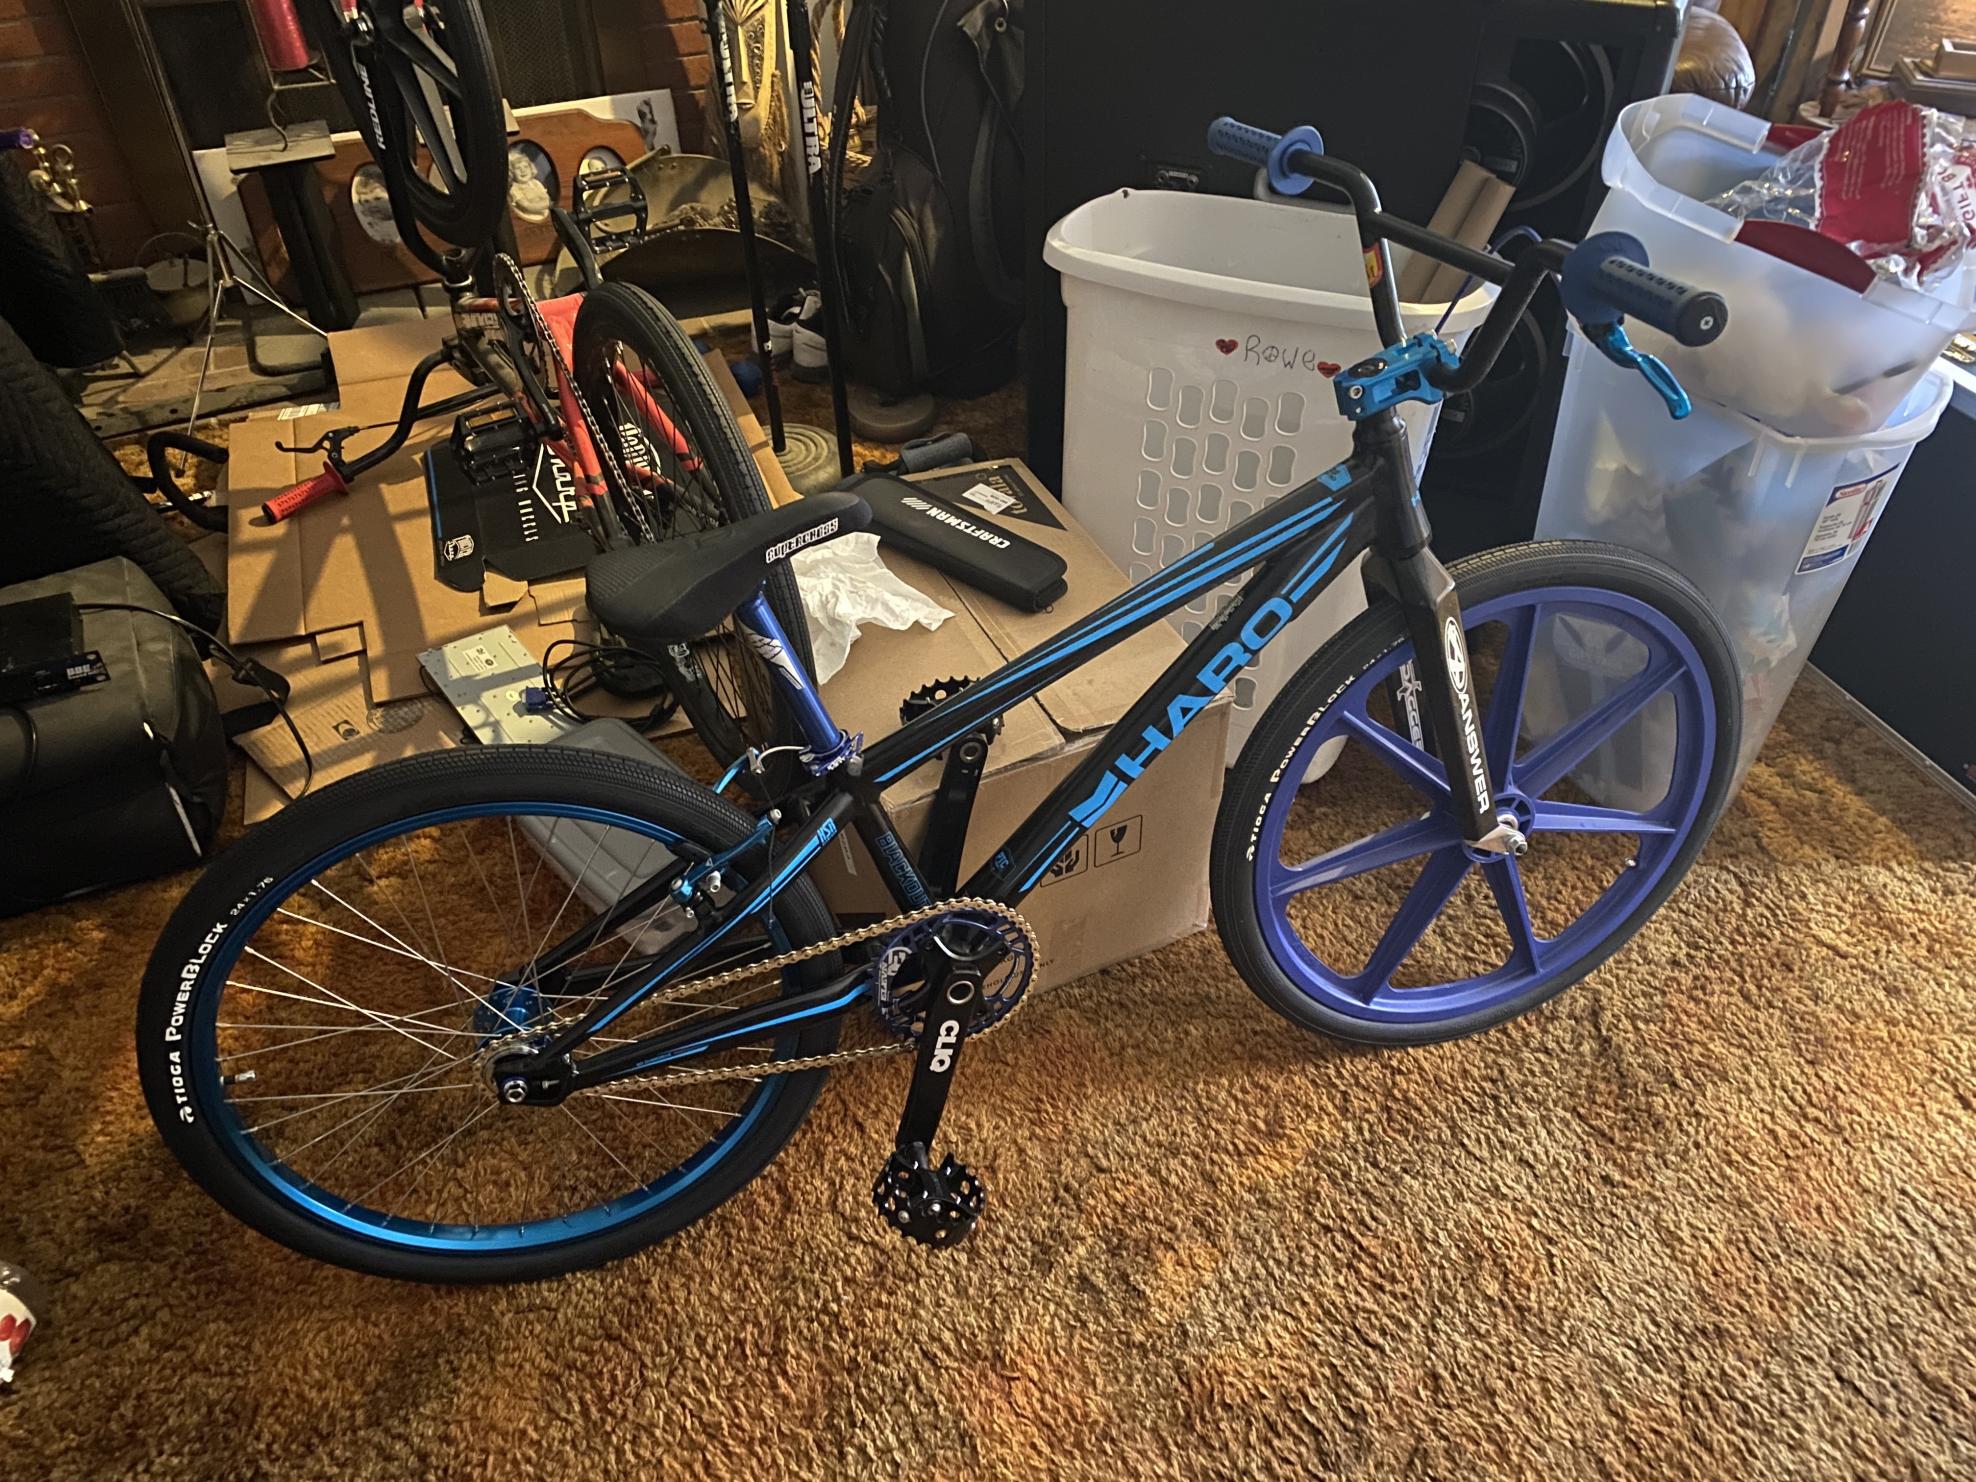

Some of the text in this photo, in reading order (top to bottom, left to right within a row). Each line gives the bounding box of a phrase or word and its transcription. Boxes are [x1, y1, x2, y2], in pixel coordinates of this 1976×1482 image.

[357, 62, 386, 150] REDLINE
[801, 81, 822, 174] ULTRA
[926, 507, 1011, 549] CRAFTSMAN
[989, 476, 1028, 514] toala
[1114, 597, 1294, 780] HARO
[1458, 693, 1490, 814] ANSWER
[1250, 792, 1272, 844] TIOGA
[169, 1051, 188, 1104] TIOGA
